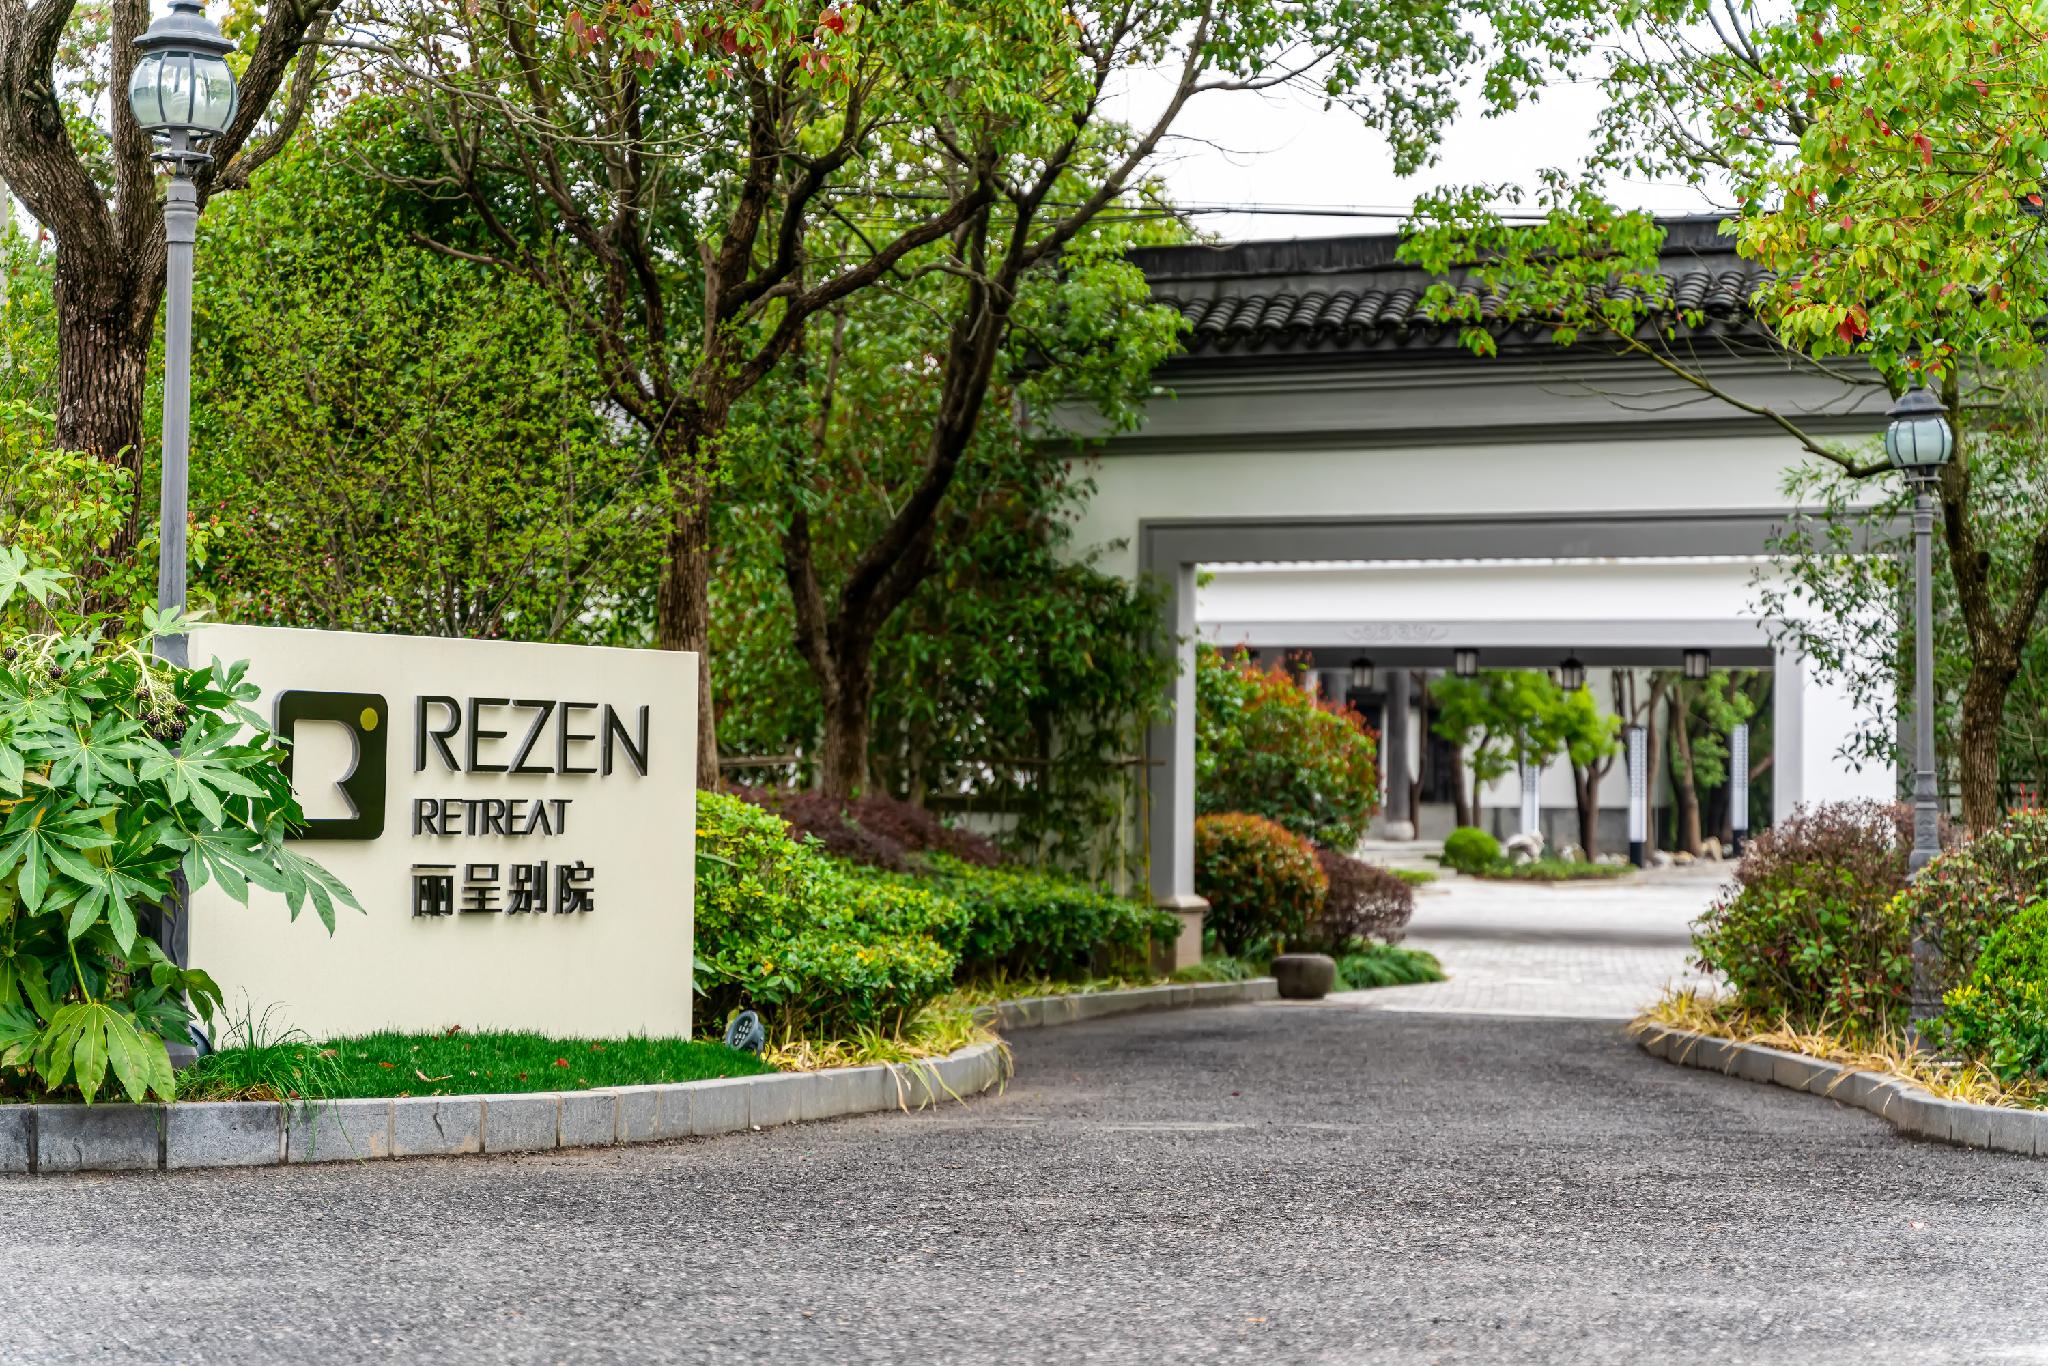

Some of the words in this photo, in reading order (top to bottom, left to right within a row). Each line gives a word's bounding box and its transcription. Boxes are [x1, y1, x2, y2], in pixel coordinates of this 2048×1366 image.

[414, 695, 649, 777] REZEN
[412, 798, 573, 836] RETREAT
[411, 860, 594, 917] 丽呈别院
